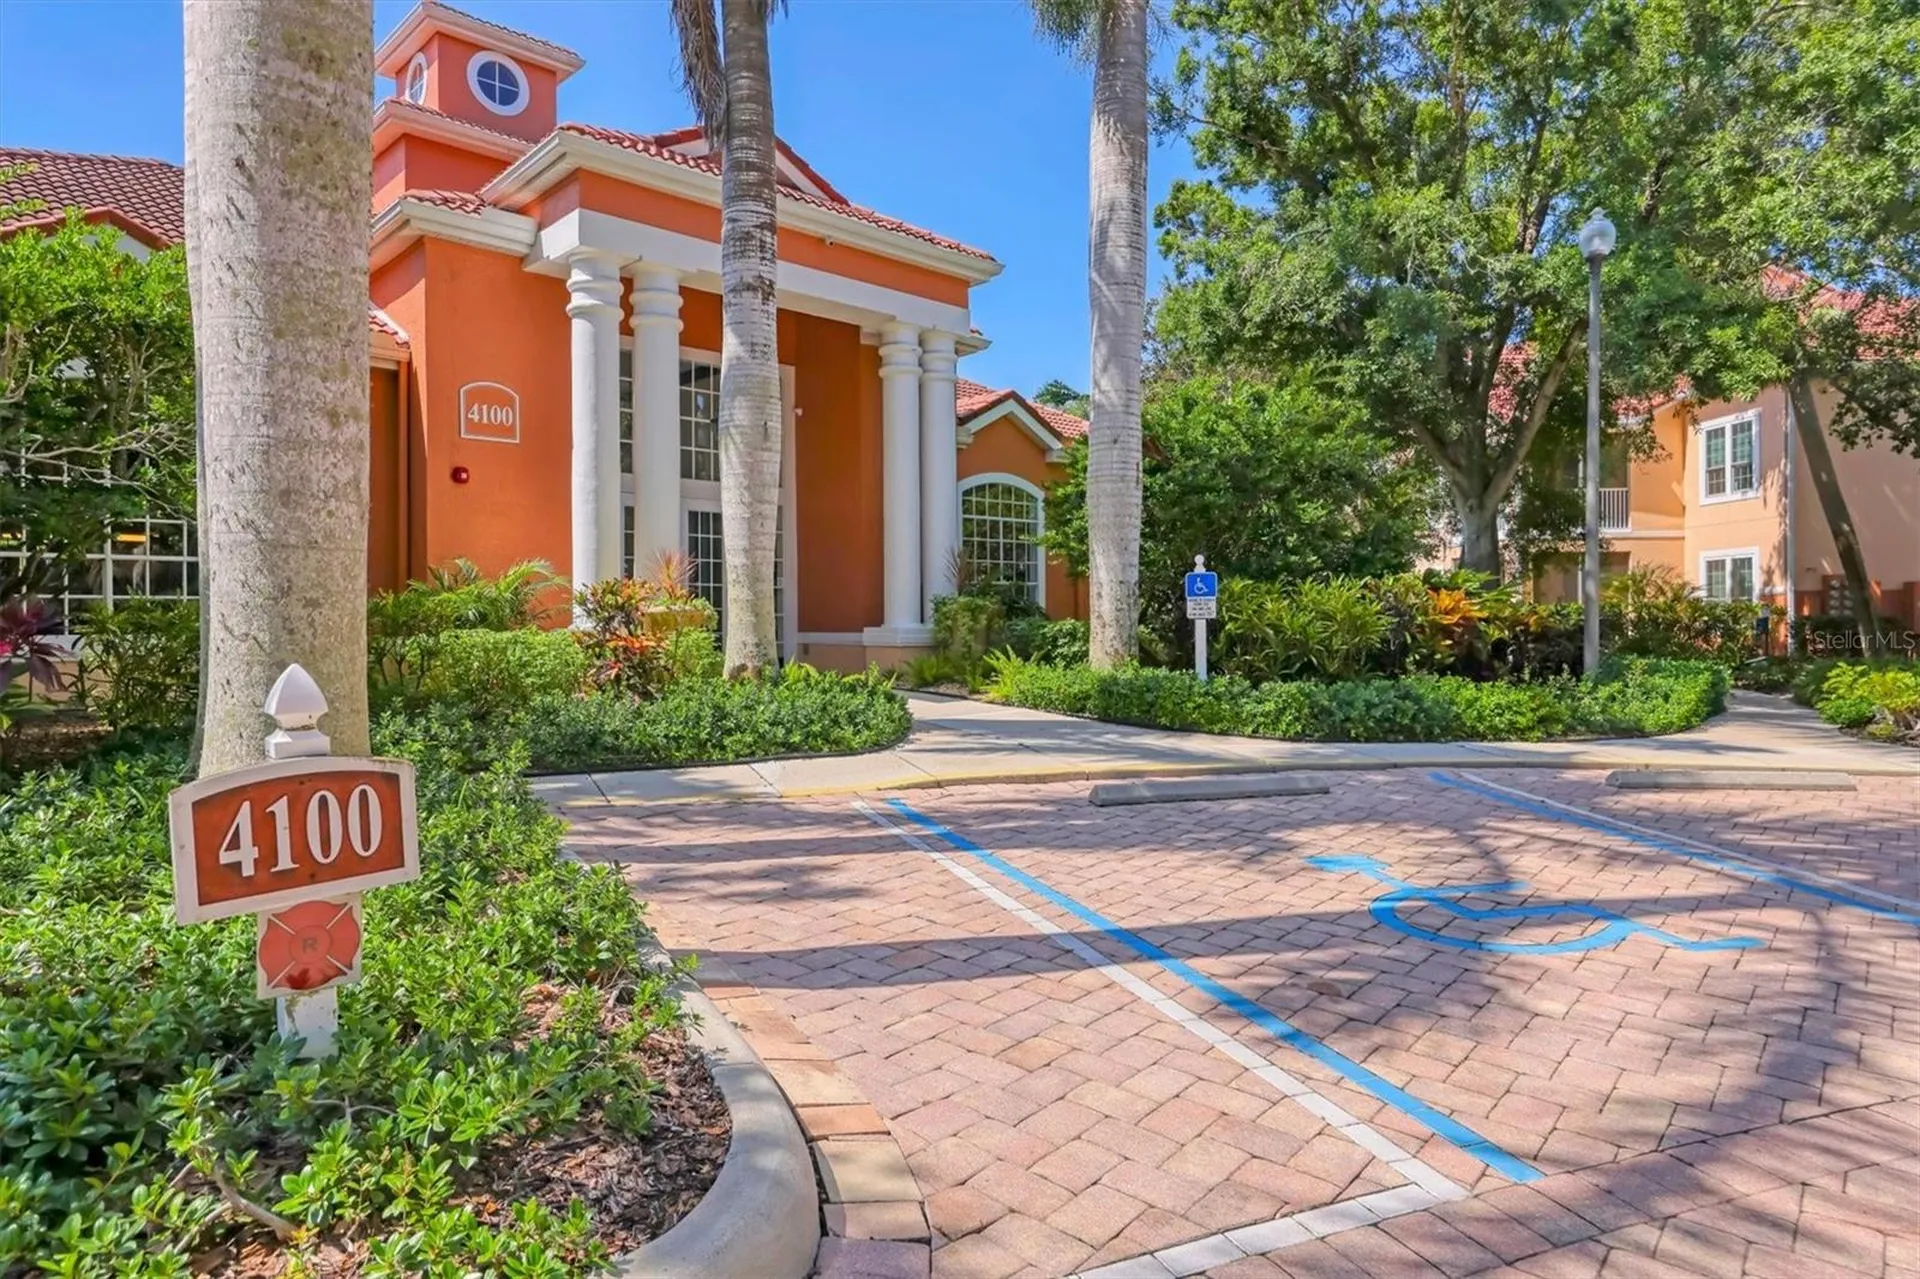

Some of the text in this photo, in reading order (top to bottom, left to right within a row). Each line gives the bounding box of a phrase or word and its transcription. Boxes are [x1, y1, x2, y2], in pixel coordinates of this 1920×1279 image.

[467, 402, 513, 427] 4100
[218, 783, 383, 878] 4100
[302, 937, 318, 953] R
